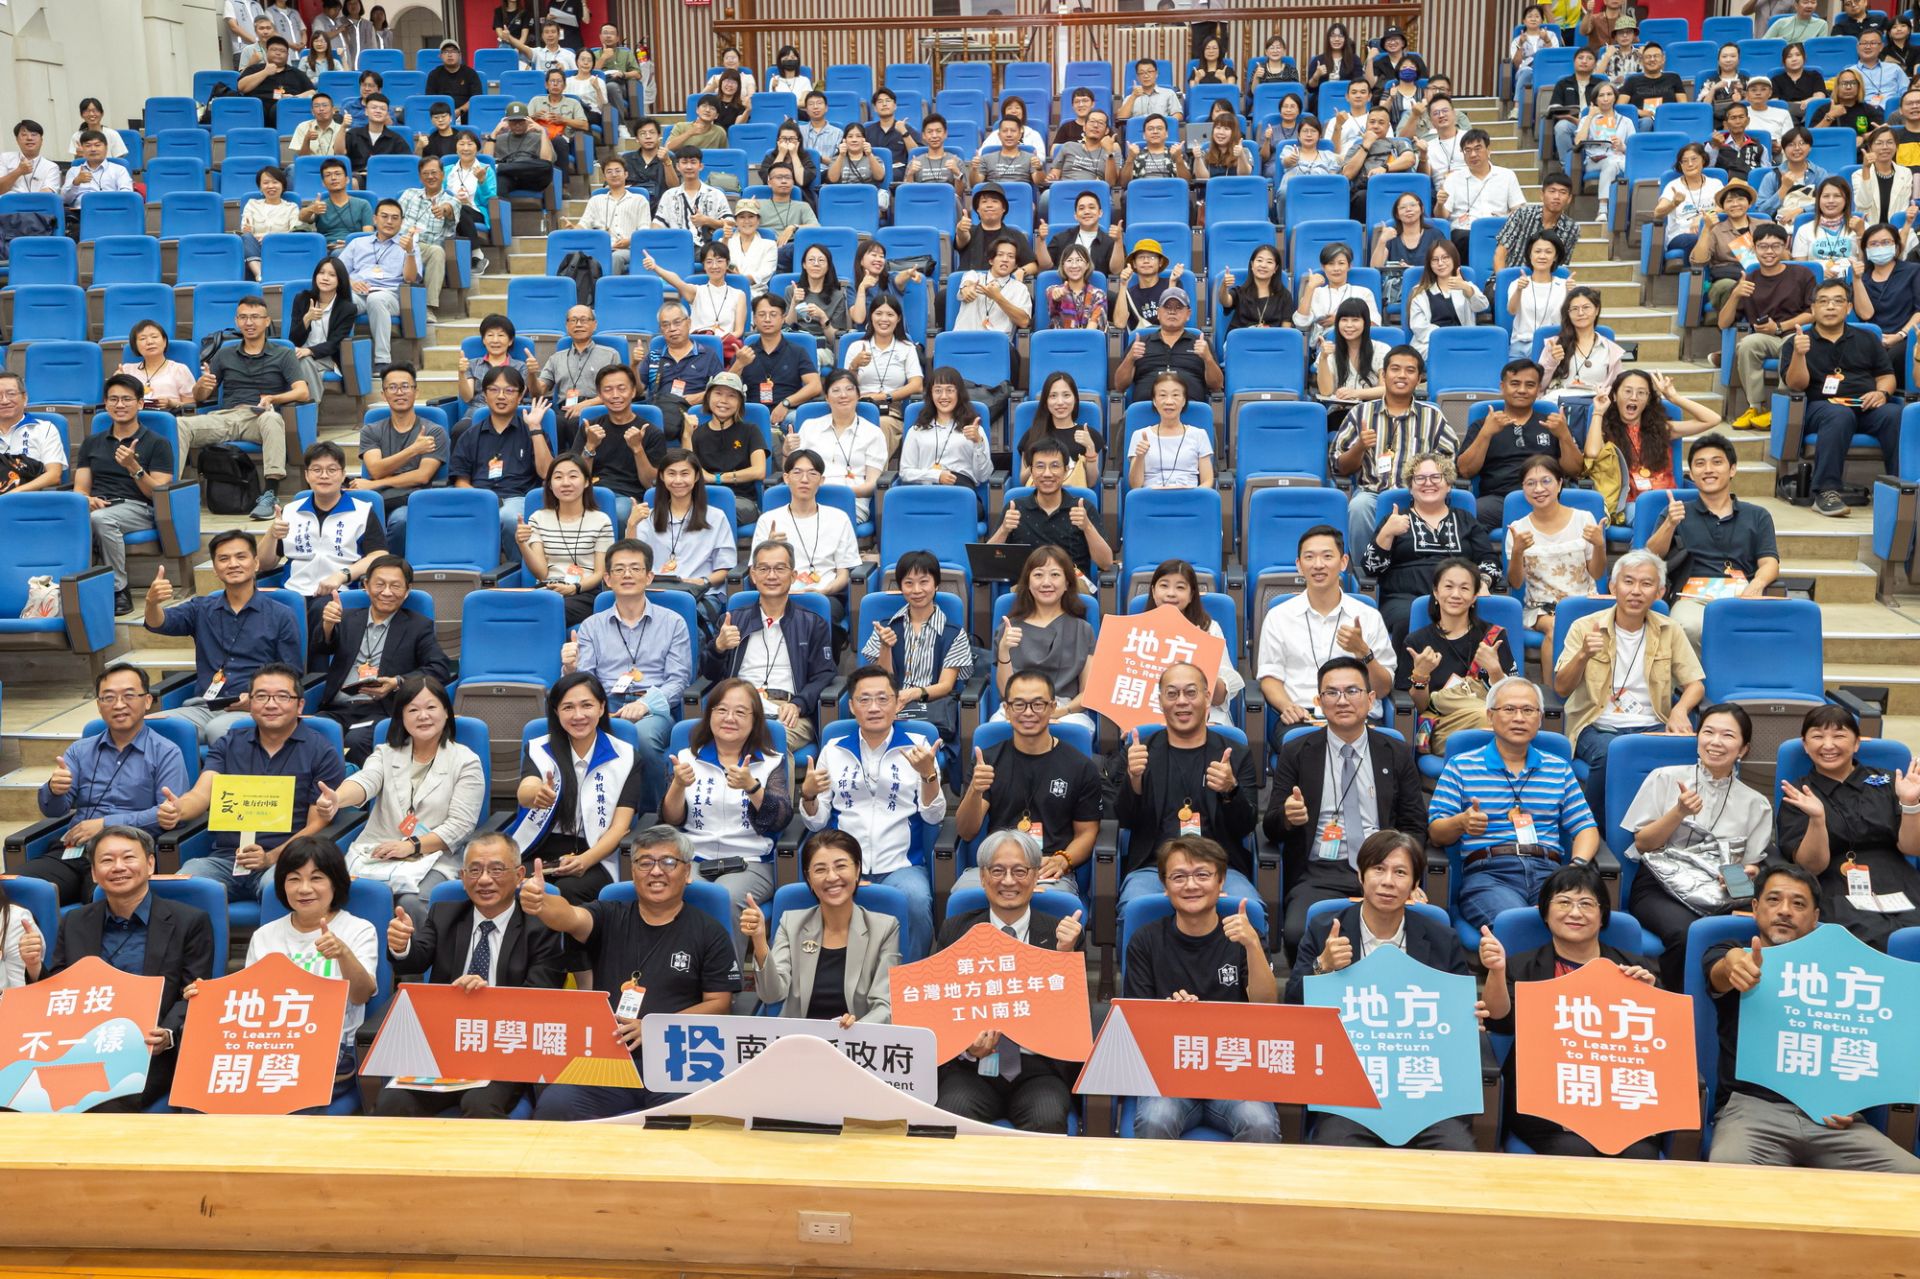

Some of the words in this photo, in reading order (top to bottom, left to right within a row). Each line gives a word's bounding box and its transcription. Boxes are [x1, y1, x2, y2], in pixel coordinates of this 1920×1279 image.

[1123, 627, 1197, 664] 地方
[1125, 657, 1136, 666] To
[1140, 661, 1168, 672] Lear
[1111, 674, 1163, 715] 開
[957, 955, 1016, 975] 第六屆
[903, 973, 1065, 1002] 台灣地方創生年會
[47, 986, 115, 1016] 南投
[1784, 1005, 1801, 1016] To
[1807, 1007, 1851, 1021] Learn
[1858, 1012, 1875, 1024] is
[223, 1030, 237, 1039] To
[243, 1030, 281, 1039] Learn
[287, 1030, 301, 1039] is
[1349, 1030, 1364, 1040] To
[1371, 1031, 1413, 1040] Learn
[1420, 1030, 1435, 1040] is
[1789, 1018, 1806, 1028] to
[1813, 1020, 1869, 1035] Return
[19, 1024, 125, 1058] 不一樣
[225, 1041, 240, 1049] to
[246, 1041, 295, 1050] Return
[1356, 1042, 1371, 1052] to
[1377, 1042, 1430, 1052] Return
[1560, 1038, 1577, 1047] To
[1583, 1039, 1627, 1052] Learn
[1633, 1042, 1650, 1054] is
[736, 1034, 914, 1075] 南政府
[1566, 1050, 1583, 1060] to
[1591, 1051, 1645, 1064] Return
[1776, 1031, 1879, 1081] 開學
[208, 1053, 301, 1094] 開學
[1556, 1063, 1659, 1110] 開學
